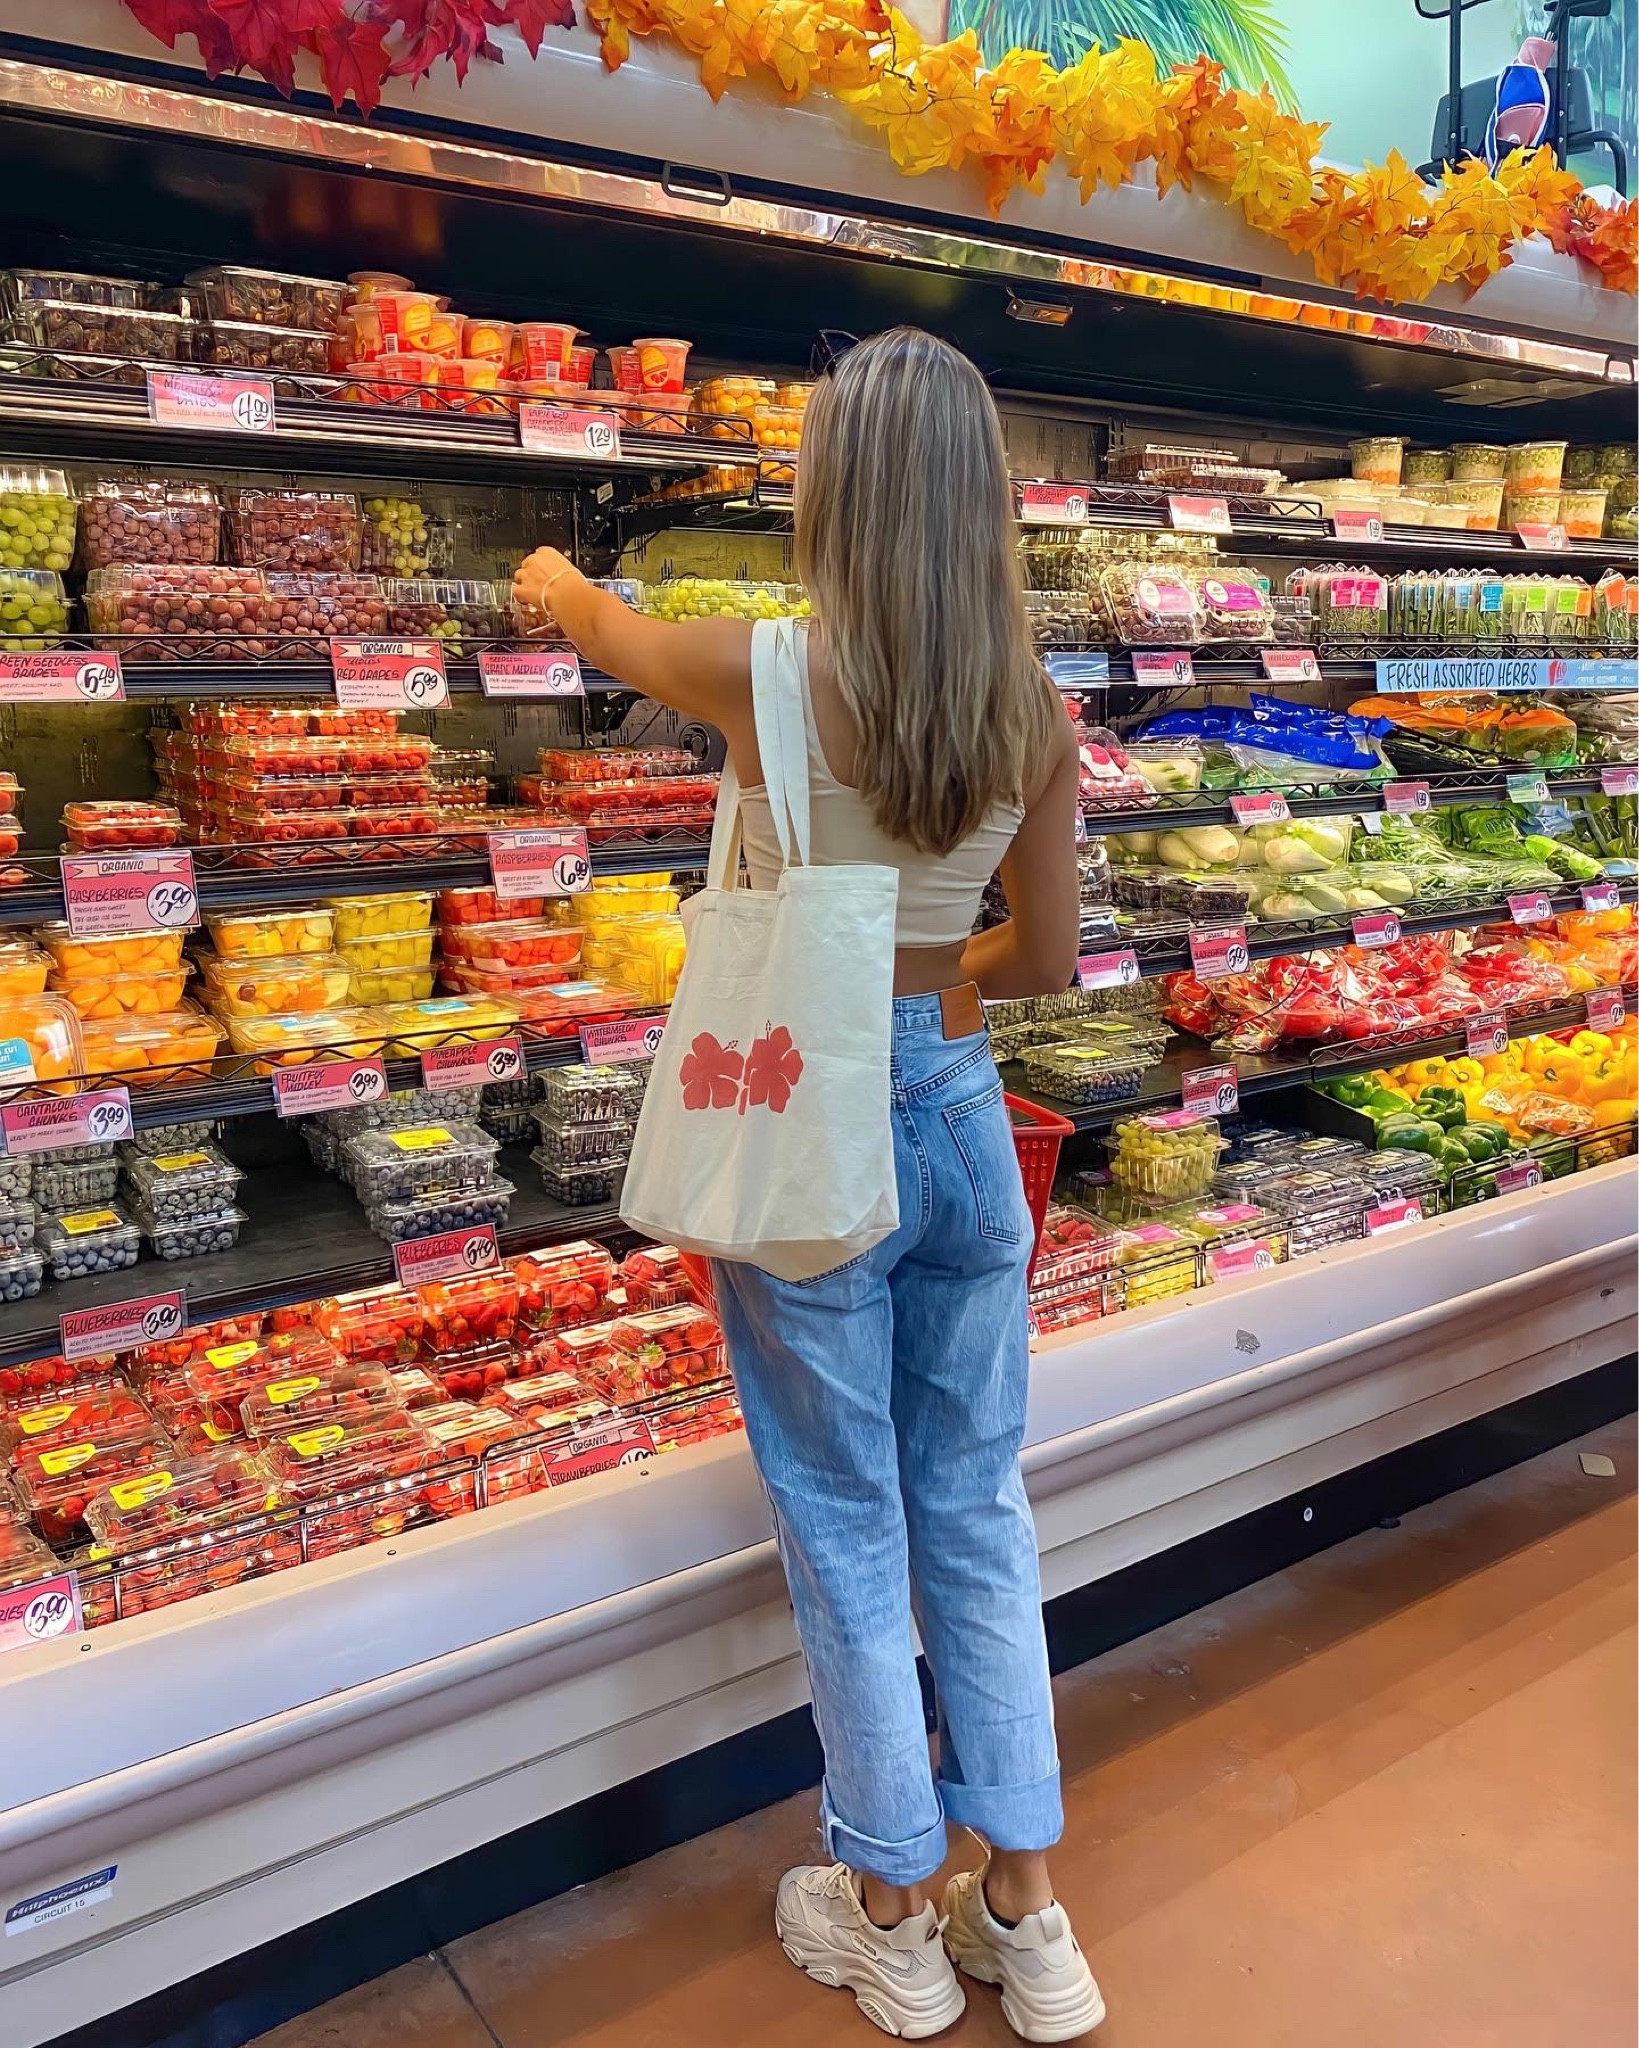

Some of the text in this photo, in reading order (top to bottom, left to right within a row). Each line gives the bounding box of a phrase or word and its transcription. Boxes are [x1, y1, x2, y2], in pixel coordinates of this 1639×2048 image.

[362, 643, 404, 655] ORGANIC
[0, 655, 31, 668] REEN
[12, 668, 60, 679] GRAPES
[336, 669, 400, 680] RED GRAPES
[1386, 661, 1429, 691] FRESH
[1432, 660, 1495, 688] ASSORTED
[1497, 660, 1537, 687] HERBS
[101, 860, 145, 873] ORGANIC
[69, 886, 146, 904] RASPBERRIES
[586, 1023, 637, 1038] WATERMELON
[593, 1034, 627, 1047] CHUNKS
[430, 1045, 478, 1061] PINEAPPLE
[436, 1057, 475, 1070] CHUNKS
[16, 1097, 86, 1118] CANTALOUPE
[29, 1112, 78, 1127] CHUNKS
[65, 1306, 146, 1336] BLUEBERRIES
[572, 1434, 608, 1453] ORGANIC
[34, 1903, 72, 1923] CIRCUIT
